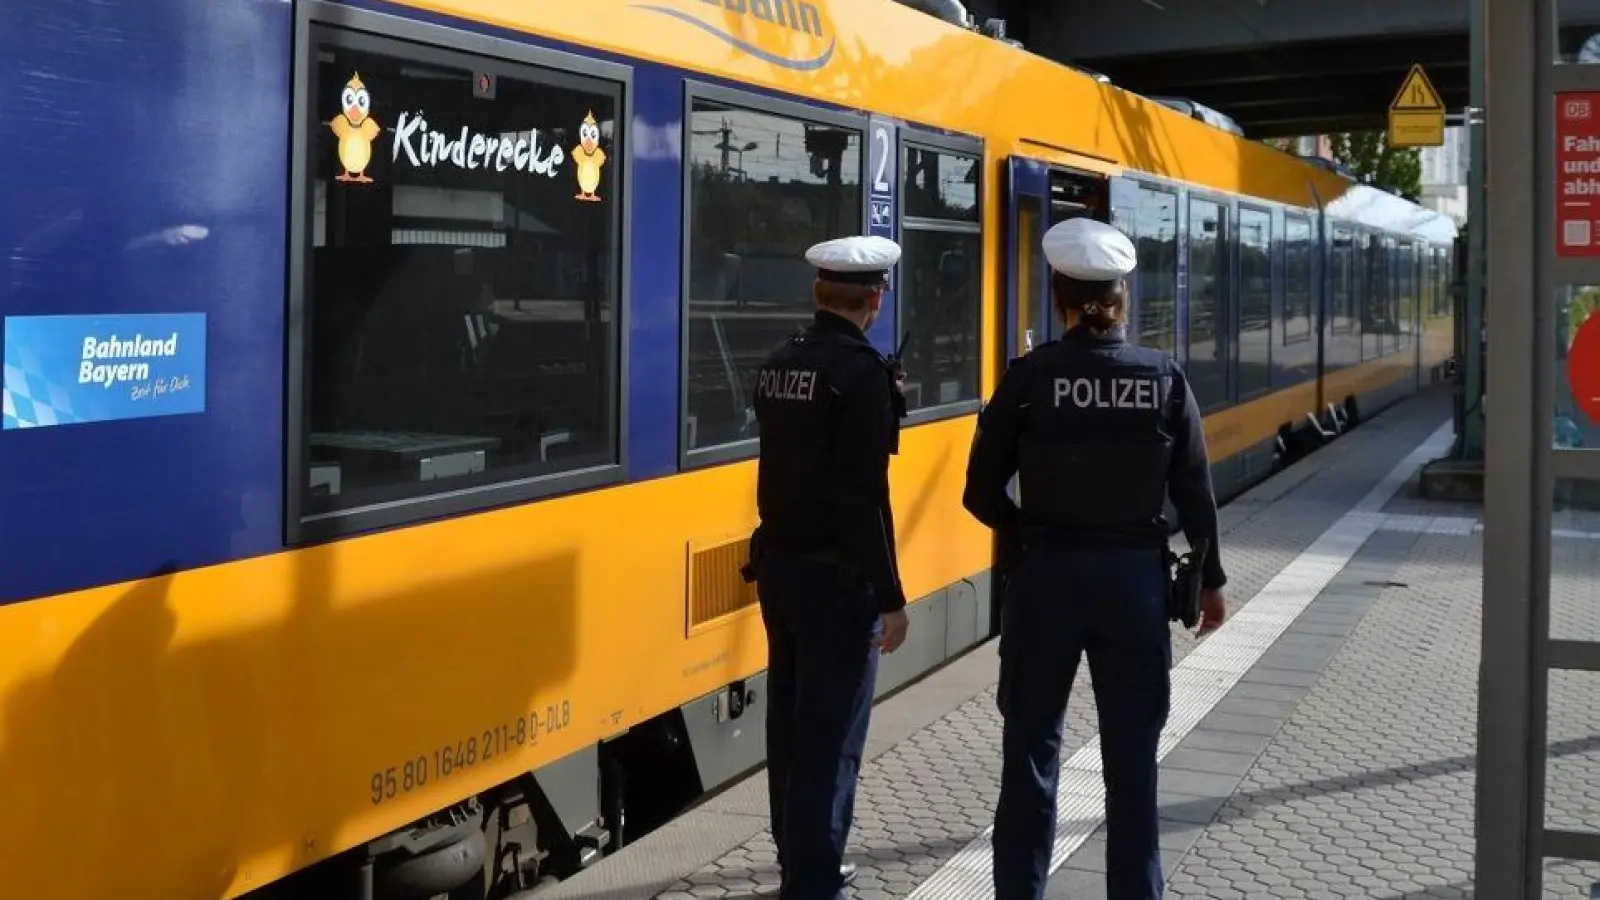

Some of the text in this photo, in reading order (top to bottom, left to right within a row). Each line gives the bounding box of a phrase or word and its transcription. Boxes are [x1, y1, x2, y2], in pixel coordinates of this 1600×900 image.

[392, 110, 564, 178] Kinderecke
[874, 127, 889, 192] 2
[82, 332, 178, 360] Bahnland
[78, 361, 149, 389] Bayern
[757, 368, 817, 401] POLIZEI
[1053, 378, 1160, 409] POLIZEI
[371, 766, 396, 804] 95
[402, 755, 428, 792] 80
[434, 735, 478, 780] 1648
[482, 716, 526, 761] 211-8
